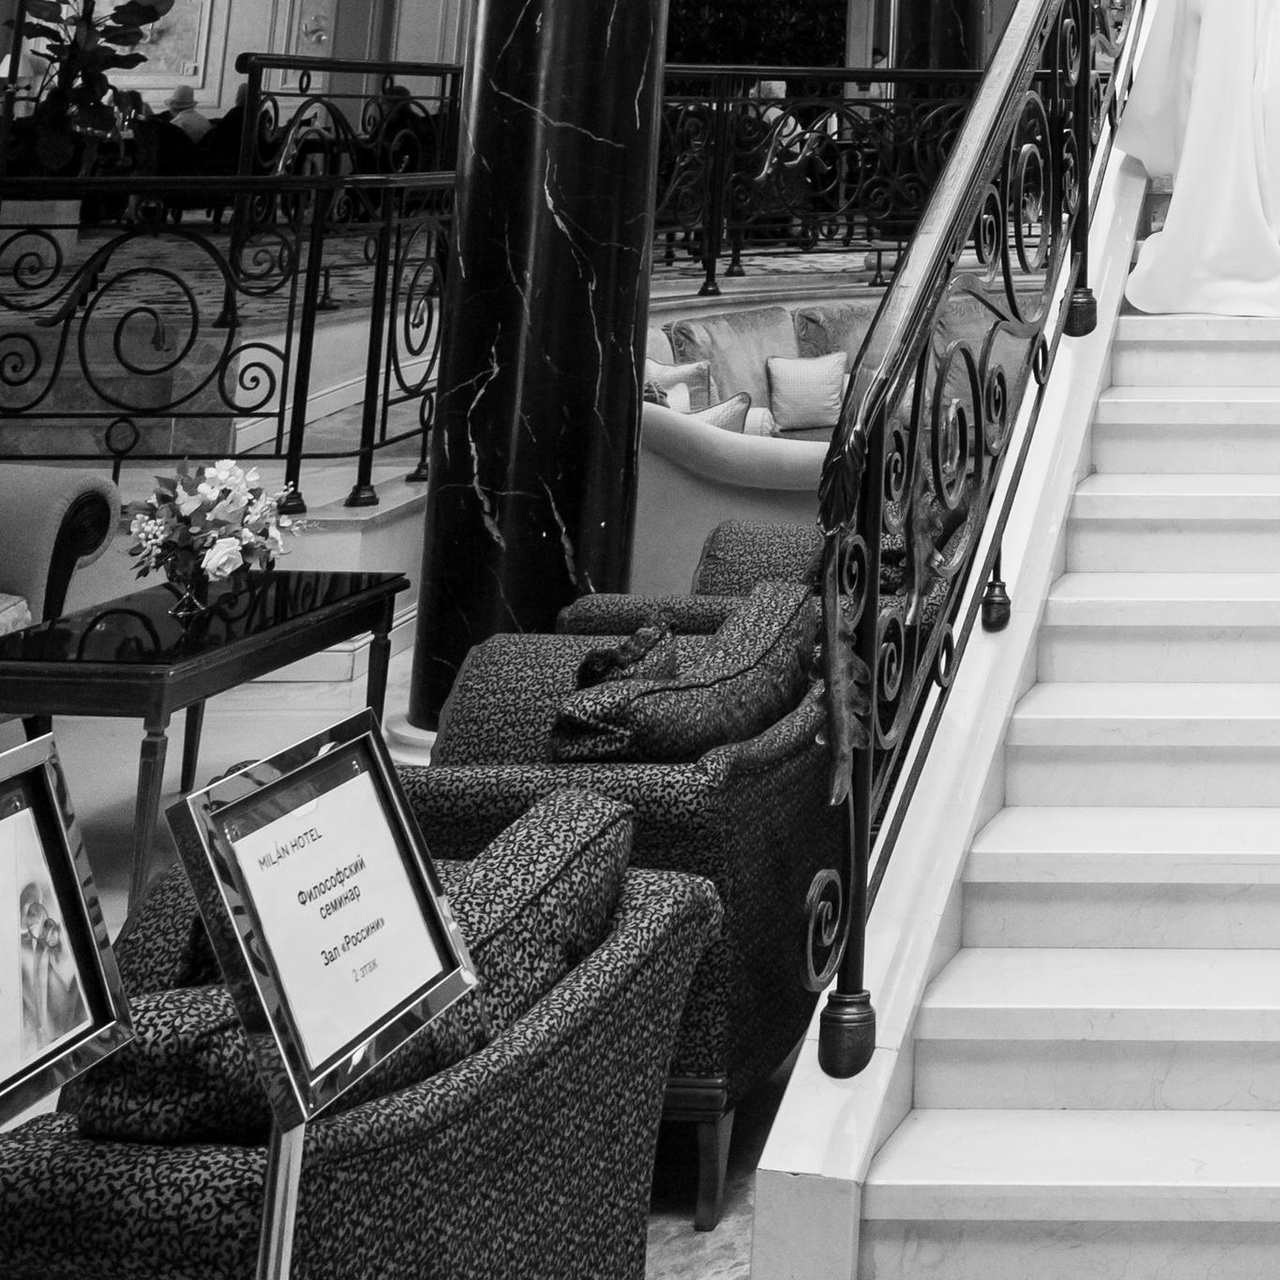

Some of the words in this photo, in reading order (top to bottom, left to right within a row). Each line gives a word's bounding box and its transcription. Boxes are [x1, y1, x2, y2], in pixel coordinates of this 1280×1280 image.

[291, 827, 322, 853] HOTEL
[297, 854, 366, 906] Философский
[319, 885, 361, 919] семинар
[320, 946, 341, 966] Зал
[341, 917, 385, 953] «Россини»
[351, 968, 359, 983] 2
[360, 957, 378, 978] этаж
